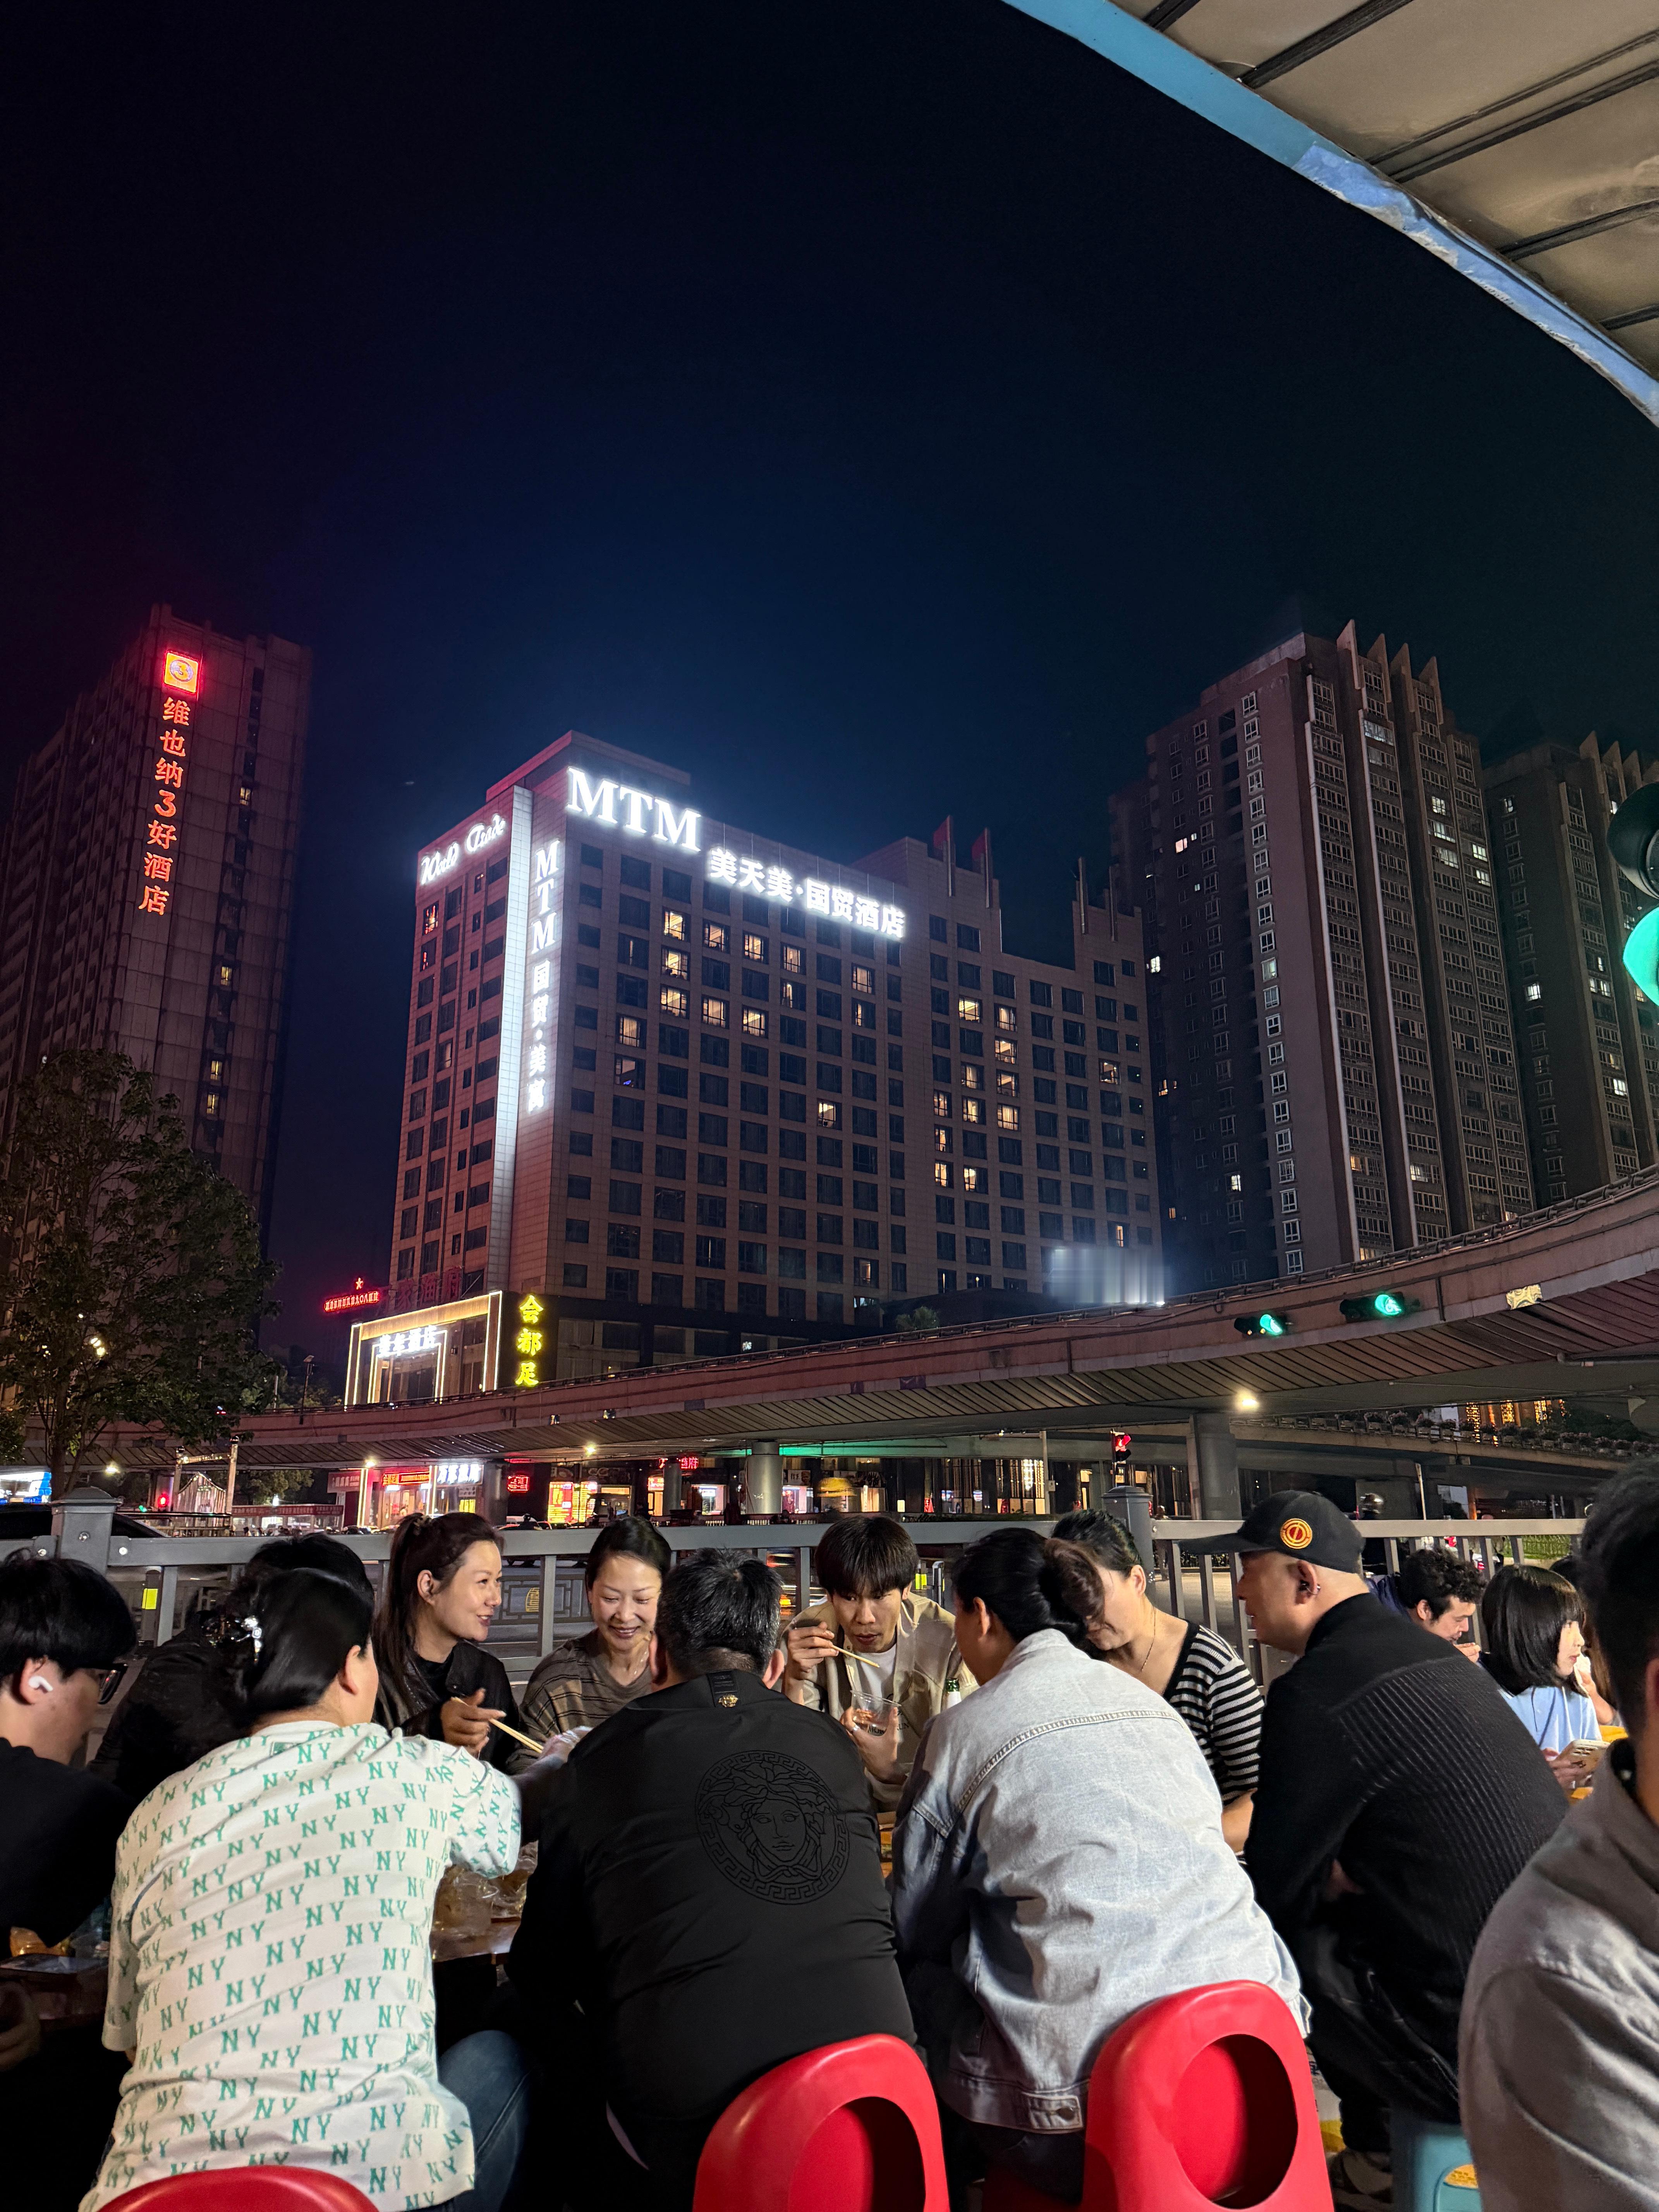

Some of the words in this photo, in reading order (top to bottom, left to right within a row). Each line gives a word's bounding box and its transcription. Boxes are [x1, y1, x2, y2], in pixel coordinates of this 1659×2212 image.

[138, 697, 190, 915] 维也纳3好酒店
[567, 767, 701, 851] MTM
[466, 814, 505, 852] Trade
[710, 848, 904, 938] 美天美·国贸酒店
[297, 1742, 330, 1764] NY
[368, 1762, 398, 1781] NY
[192, 1783, 225, 1809] NY
[299, 1774, 332, 1797] NY
[335, 1786, 369, 1810] NY
[402, 1783, 426, 1802] NY
[264, 1803, 299, 1828] NY
[373, 1804, 406, 1825] NY
[450, 1789, 467, 1821] NY
[139, 1815, 160, 1846] NY
[160, 1815, 191, 1848] NY
[302, 1815, 336, 1838] NY
[430, 1809, 447, 1831] NY
[229, 1834, 263, 1858] NY
[340, 1829, 374, 1850] NY
[407, 1828, 429, 1850] NY
[266, 1844, 301, 1868] NY
[304, 1856, 340, 1879] NY
[377, 1851, 405, 1872] NY
[426, 1856, 440, 1882] NY
[164, 1857, 191, 1890] NY
[193, 1865, 226, 1898] NY
[344, 1875, 378, 1897] NY
[228, 1872, 264, 1904] NY
[265, 1884, 304, 1914] NY
[408, 1877, 424, 1897] NY
[140, 1898, 163, 1930] NY
[306, 1901, 344, 1929] NY
[380, 1899, 407, 1920] NY
[191, 1911, 225, 1941] NY
[227, 1921, 265, 1950] NY
[347, 1922, 383, 1947] NY
[266, 1936, 306, 1968] NY
[383, 1948, 410, 1971] NY
[189, 1957, 225, 1990] NY
[307, 1953, 345, 1980] NY
[227, 1974, 266, 2007] NY
[263, 1986, 304, 2016] NY
[344, 1977, 381, 2002] NY
[161, 1999, 187, 2032] NY
[302, 2009, 342, 2039] NY
[379, 2006, 406, 2028] NY
[222, 2025, 261, 2054] NY
[342, 2034, 378, 2061] NY
[261, 2045, 301, 2069] NY
[220, 2078, 258, 2102] NY
[300, 2069, 339, 2093] NY
[254, 2098, 297, 2121] NY
[371, 2103, 406, 2131] NY
[180, 2110, 217, 2136] NY
[292, 2114, 331, 2144] NY
[210, 2127, 249, 2151] NY
[331, 2139, 370, 2166] NY
[369, 2167, 401, 2195] NY
[427, 2157, 457, 2183] NY
